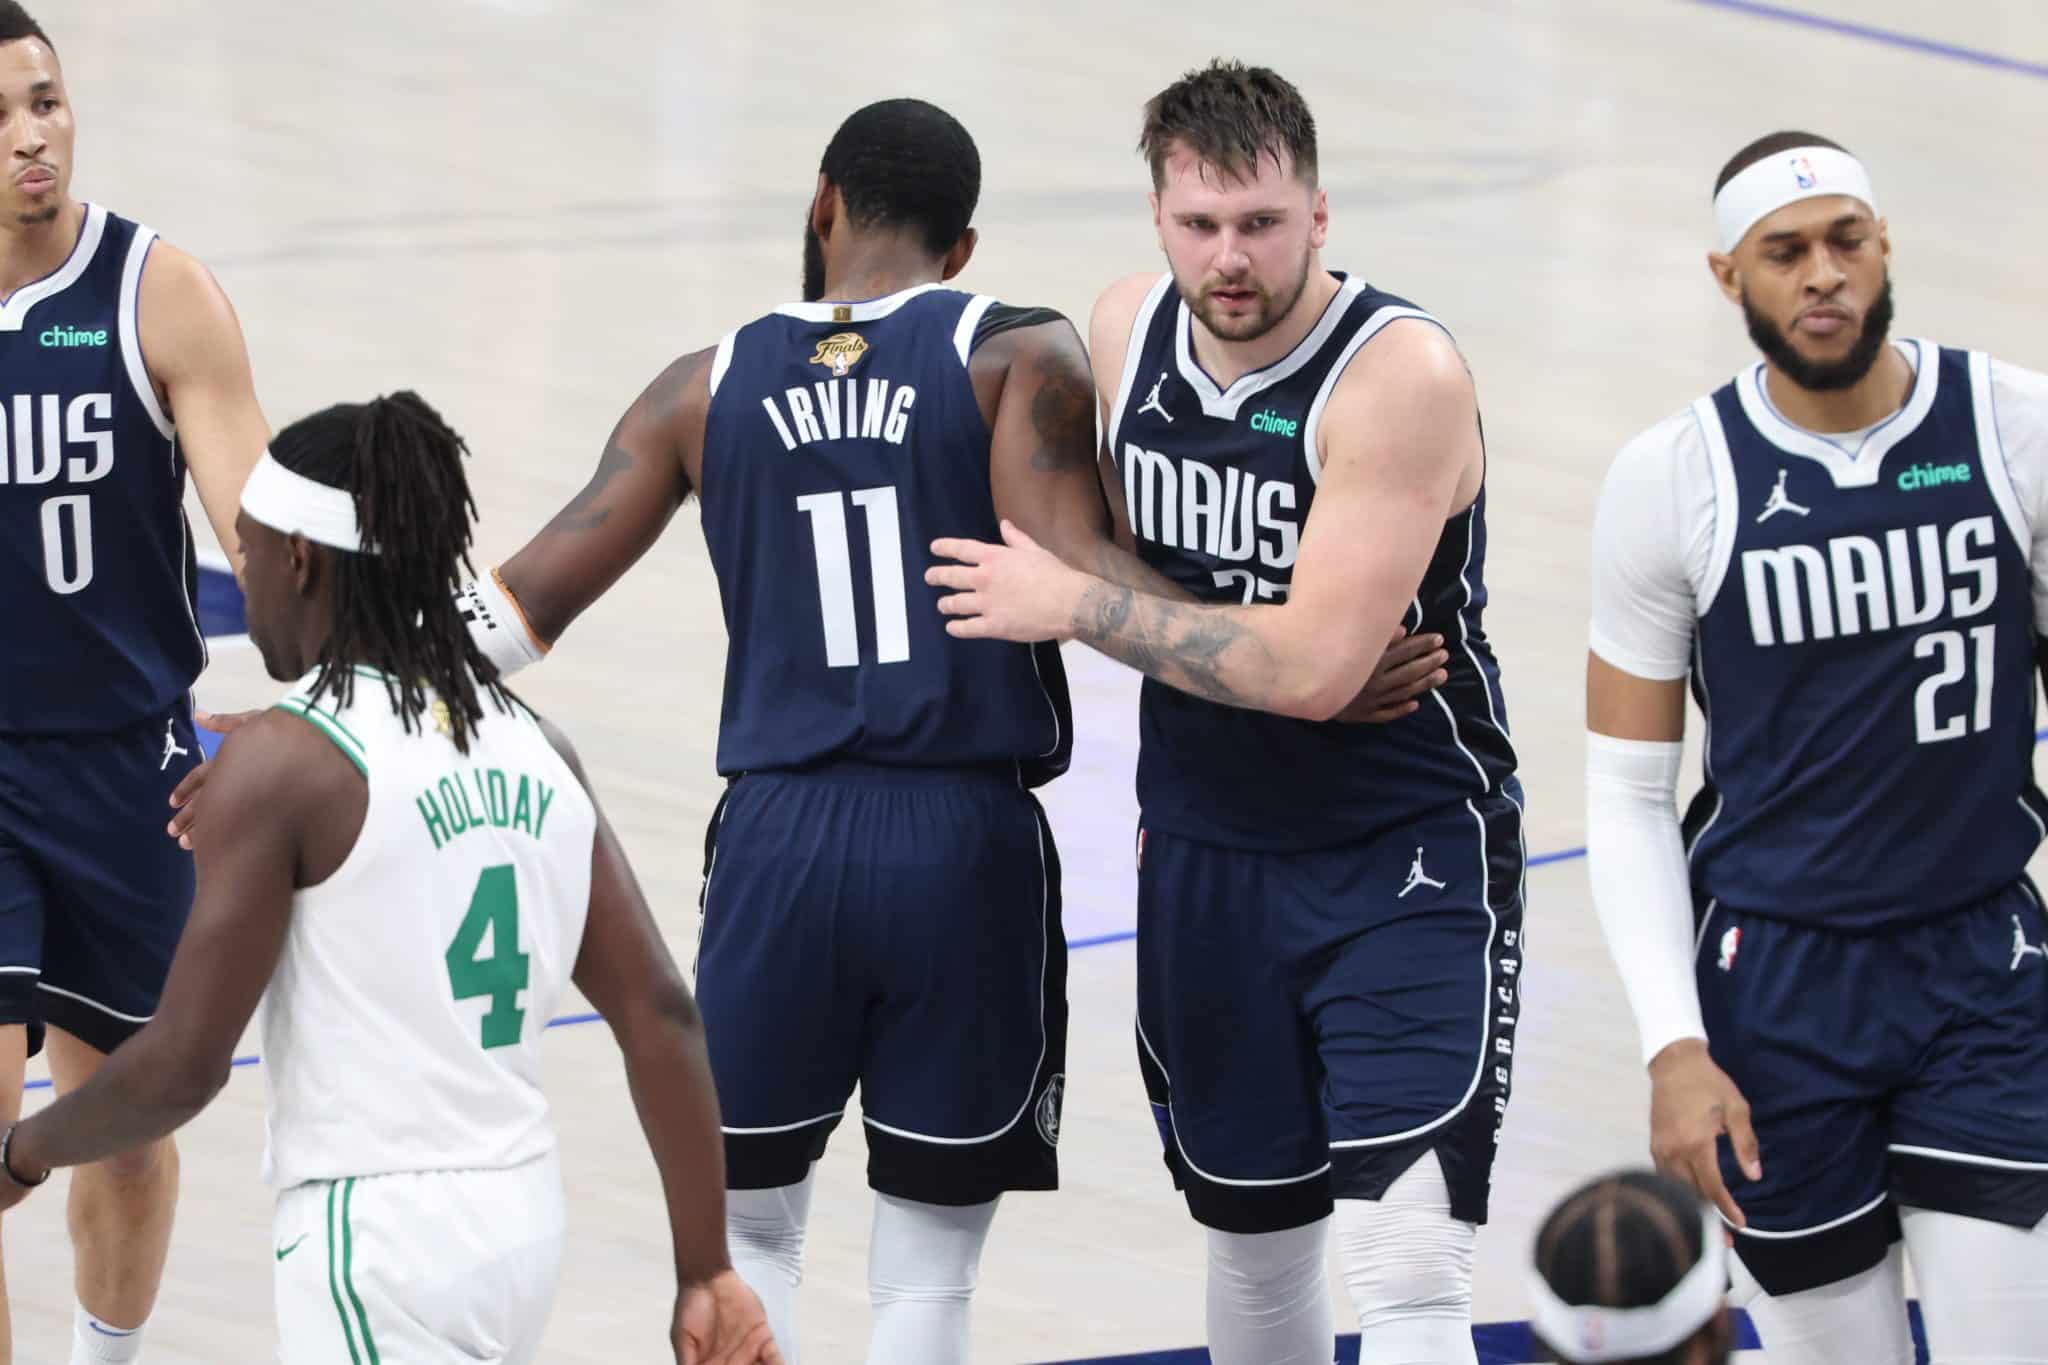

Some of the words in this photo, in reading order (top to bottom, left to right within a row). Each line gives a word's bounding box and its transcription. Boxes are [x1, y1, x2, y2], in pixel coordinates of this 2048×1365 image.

[40, 326, 108, 348] chime
[813, 337, 865, 361] Finals
[0, 393, 114, 485] VS
[762, 378, 916, 451] IRVING
[1250, 409, 1297, 437] chime
[1124, 442, 1299, 569] MAVS
[1897, 462, 1971, 490] chime
[41, 494, 94, 595] 0
[797, 485, 910, 668] 11
[1742, 515, 1998, 646] MAVS
[1914, 624, 1997, 744] 21
[416, 768, 554, 850] HOLIDAY
[445, 864, 529, 1049] 4
[1488, 928, 1519, 1186] VERICKS
